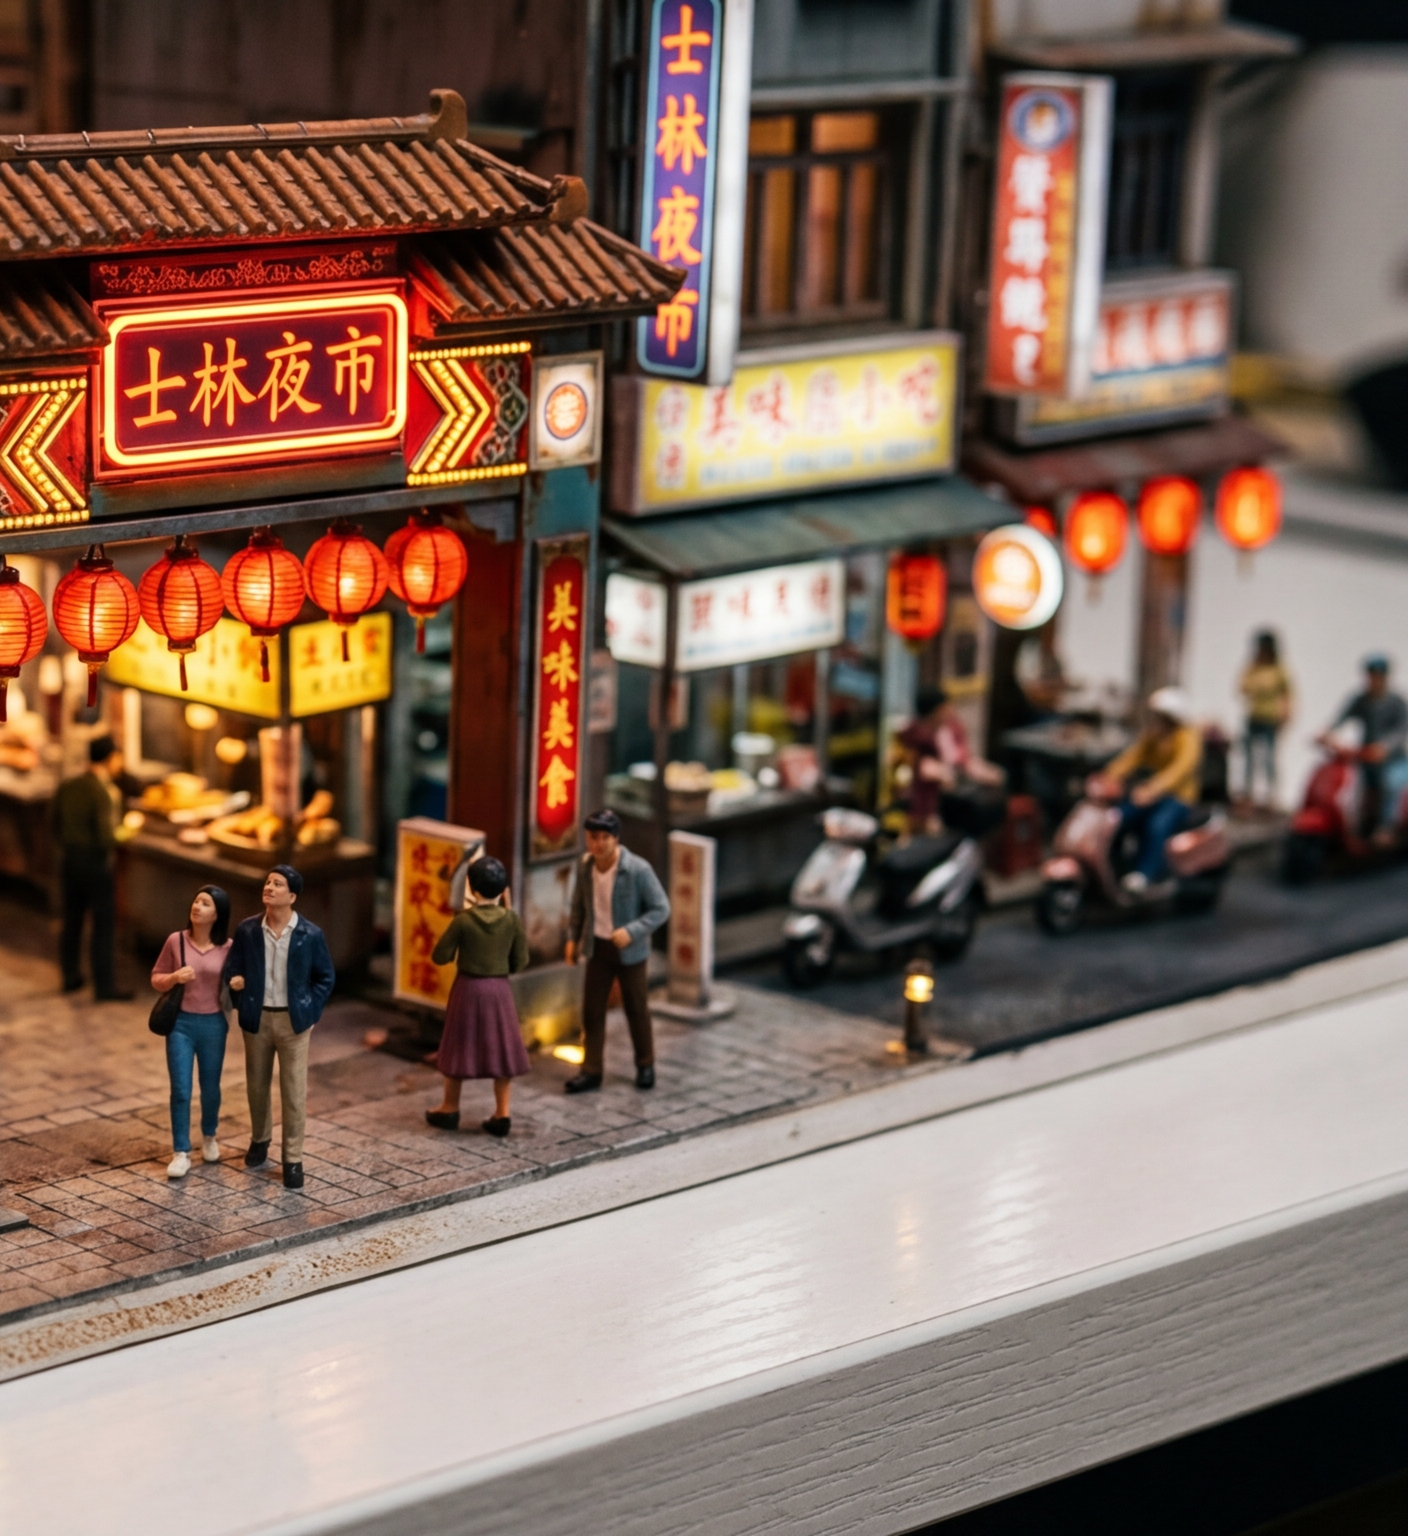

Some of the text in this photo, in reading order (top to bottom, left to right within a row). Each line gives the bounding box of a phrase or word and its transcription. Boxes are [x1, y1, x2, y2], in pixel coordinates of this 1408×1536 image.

[652, 5, 712, 357] 士林夜市
[124, 326, 382, 429] 士林夜市
[540, 580, 579, 809] 美味美食
